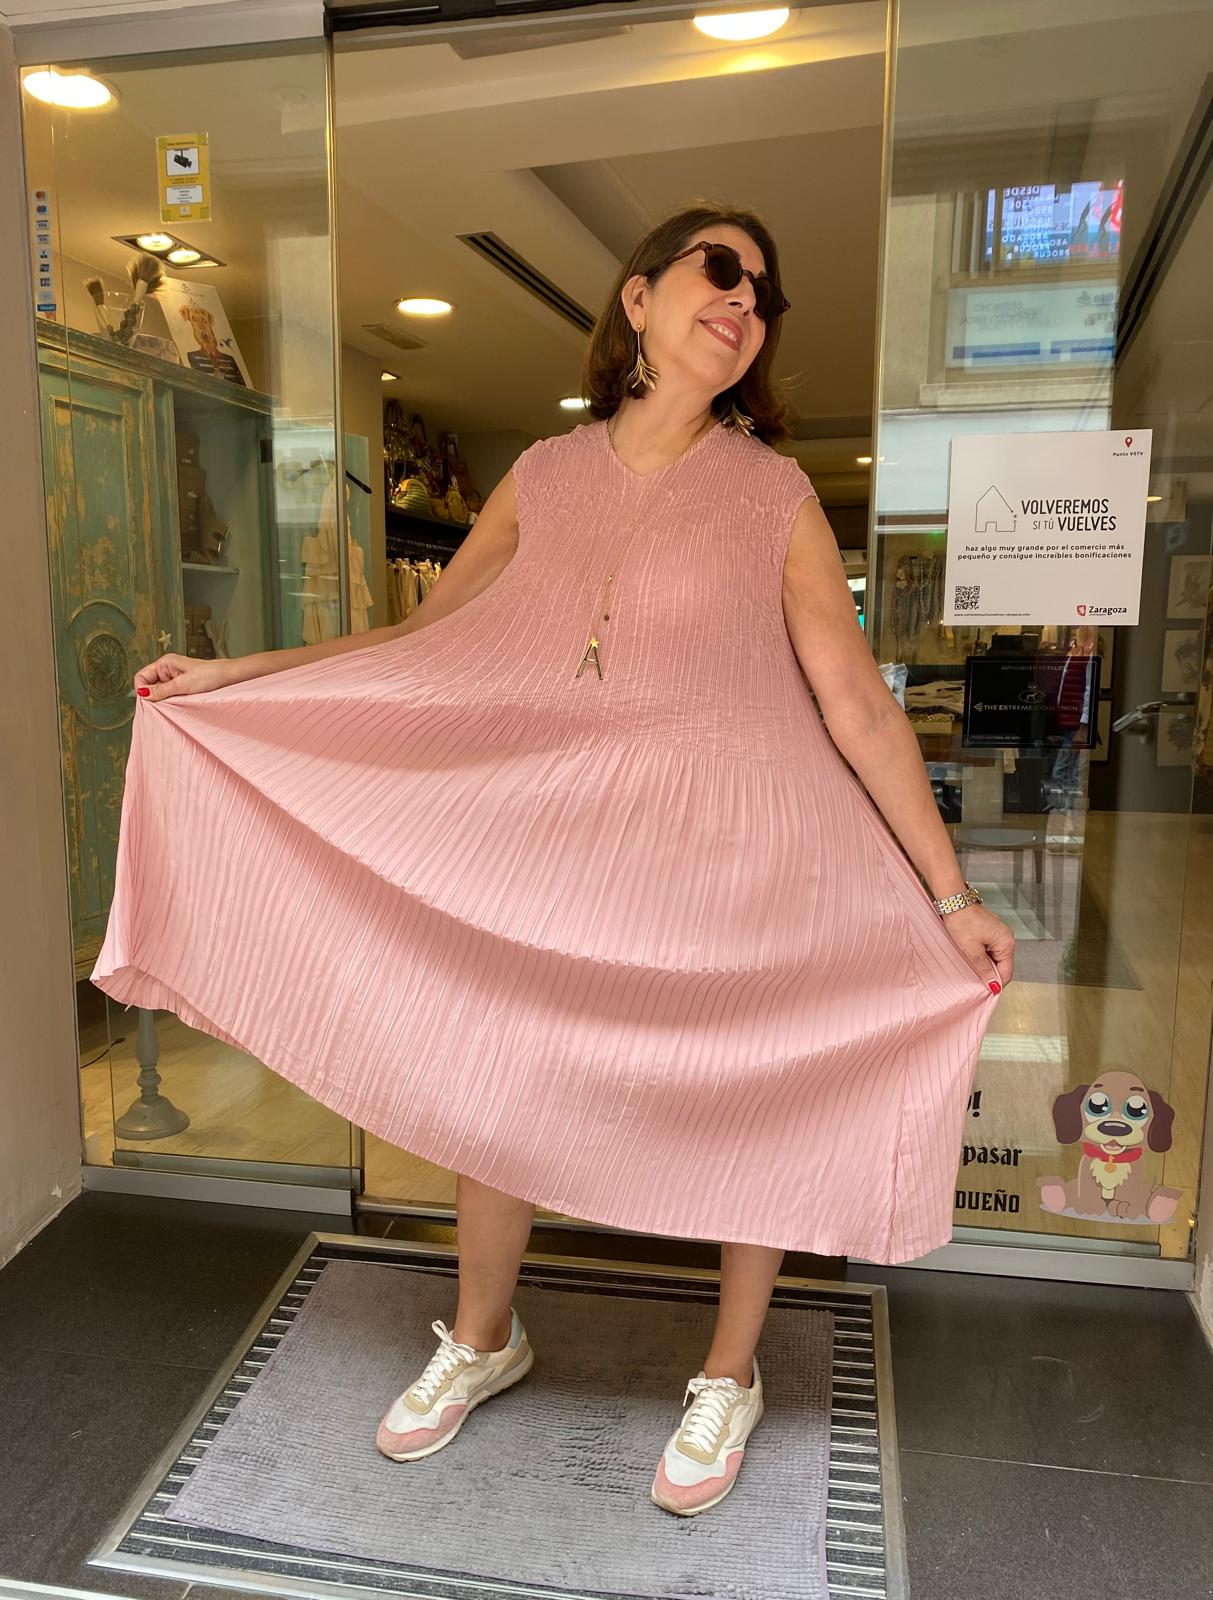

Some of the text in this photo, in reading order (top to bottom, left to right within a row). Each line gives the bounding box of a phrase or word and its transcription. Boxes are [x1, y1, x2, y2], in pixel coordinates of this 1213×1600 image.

[1021, 498, 1109, 515] VOLVEREMOS
[1032, 516, 1117, 532] SI TÚ VUELVES
[957, 553, 991, 561] pequeño
[999, 552, 1034, 561] consigue
[1075, 551, 1132, 559] bonificaciones
[980, 545, 998, 553] algo
[1017, 544, 1045, 552] grande
[1061, 543, 1069, 551] el
[1070, 543, 1107, 551] comercio
[1089, 605, 1127, 616] Zaragoza
[963, 1145, 1022, 1167] pasar
[955, 1189, 1020, 1213] DUEÑO
